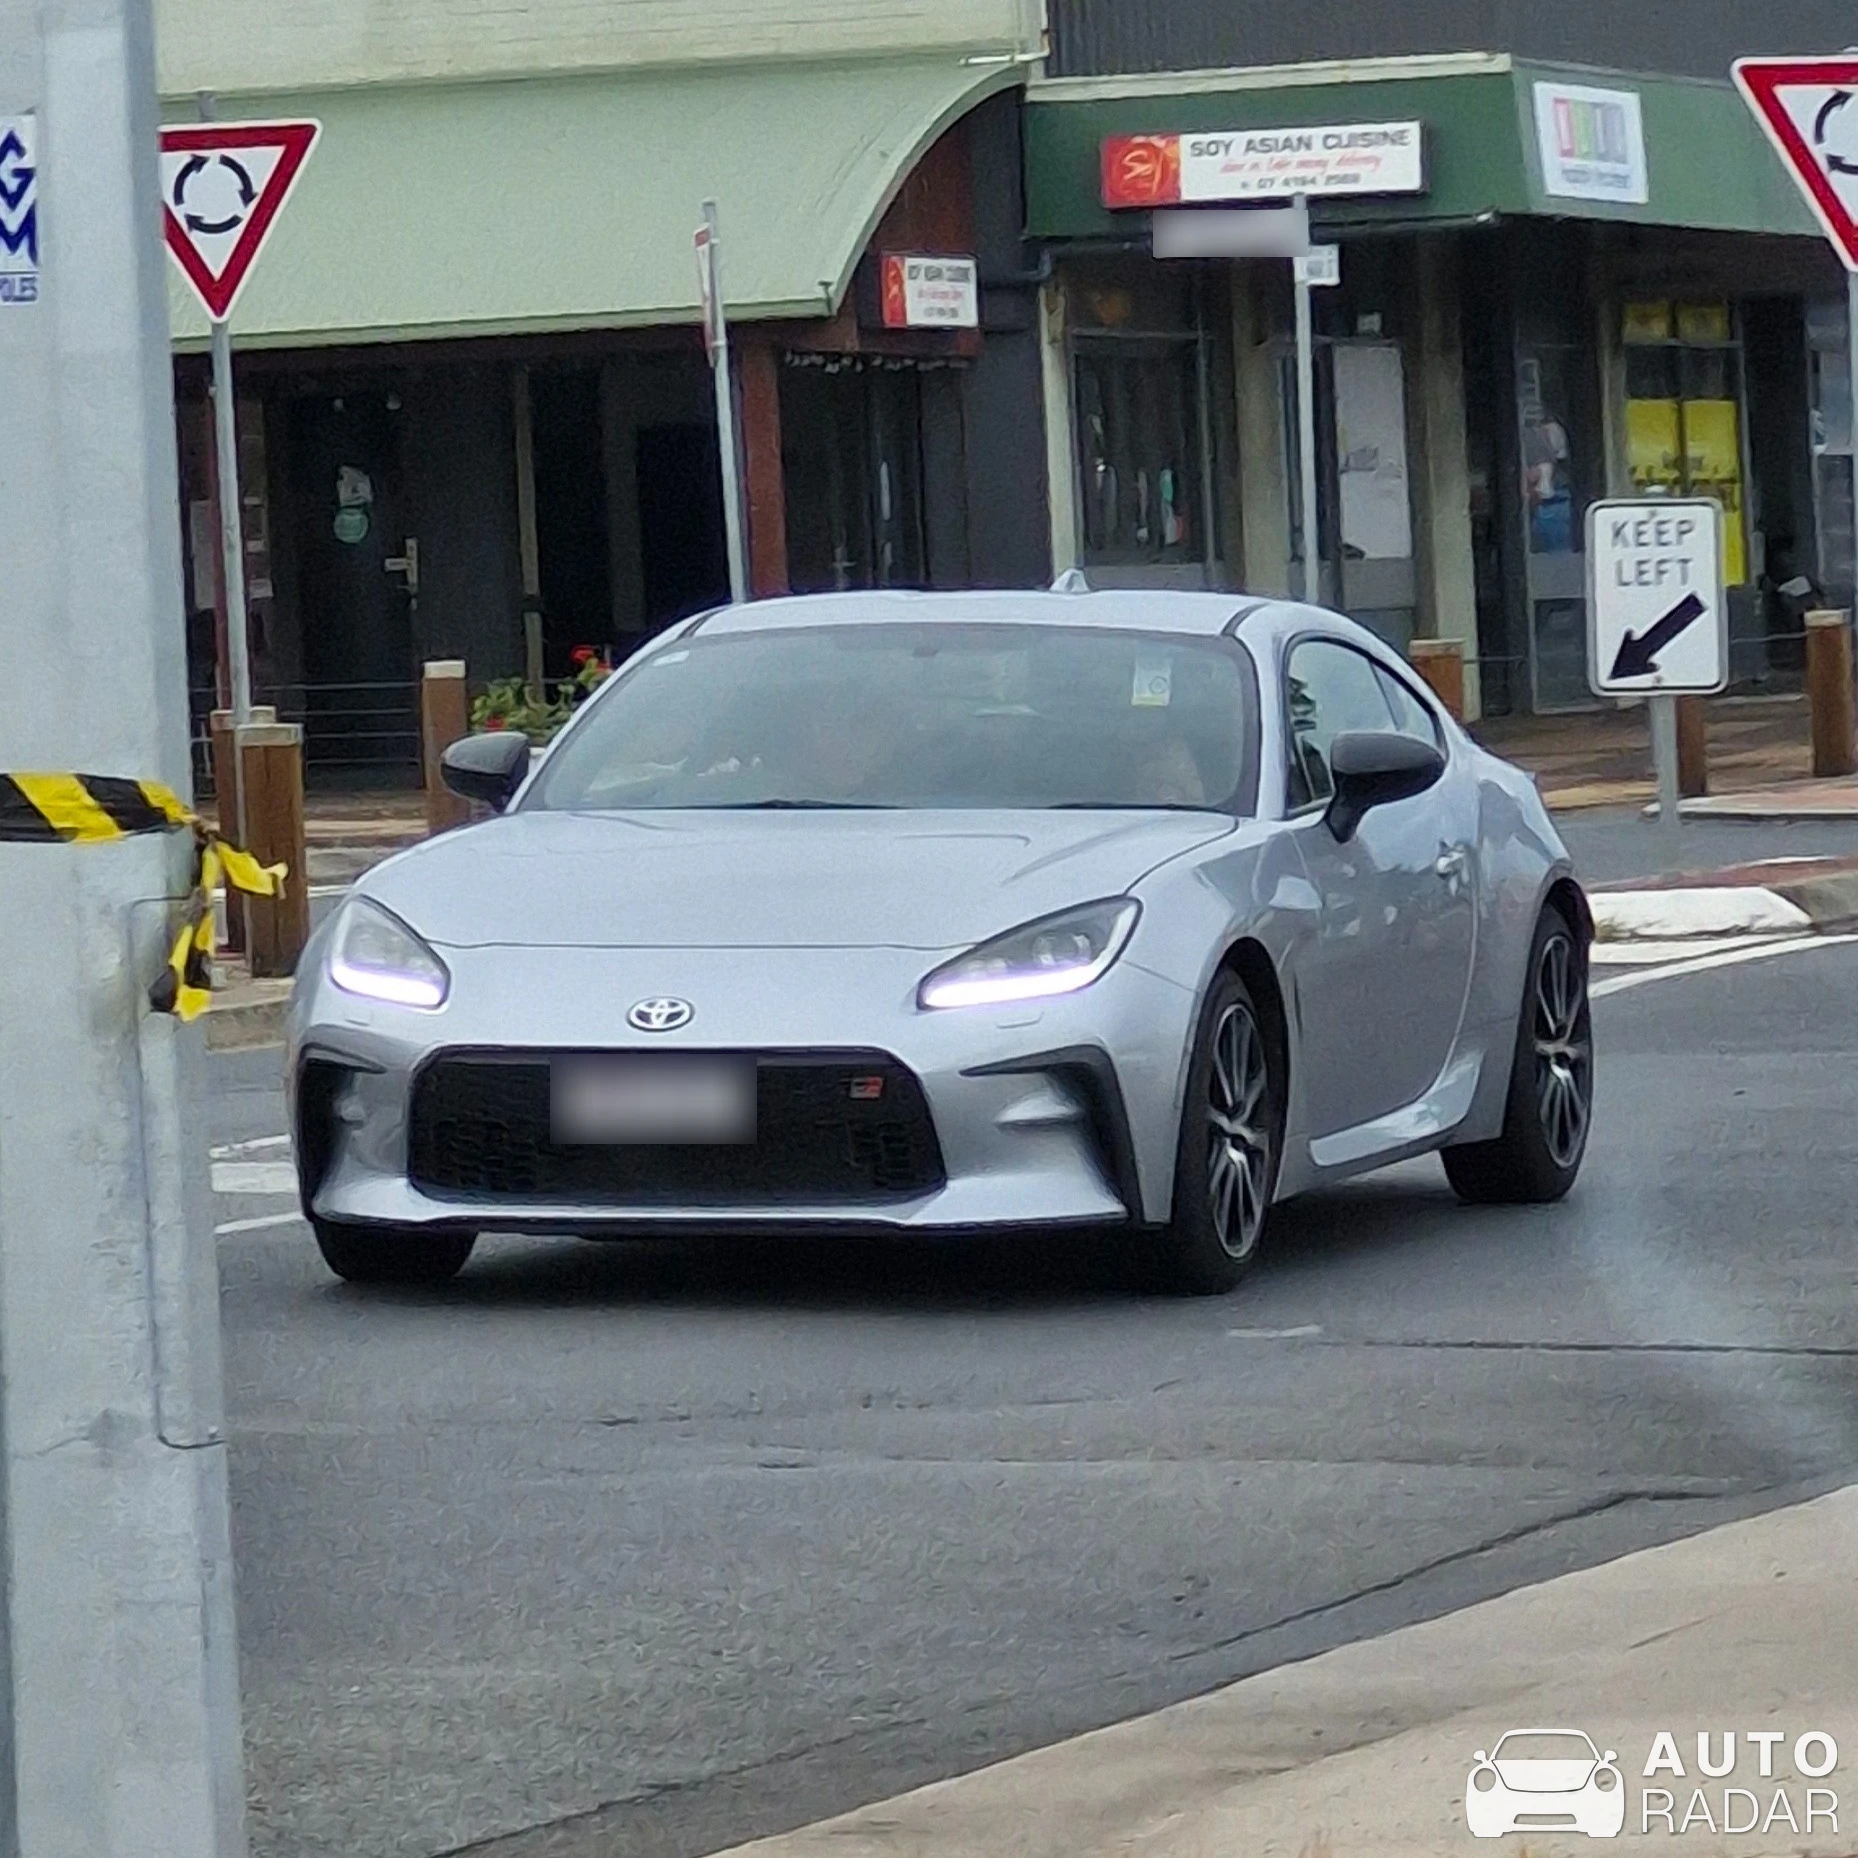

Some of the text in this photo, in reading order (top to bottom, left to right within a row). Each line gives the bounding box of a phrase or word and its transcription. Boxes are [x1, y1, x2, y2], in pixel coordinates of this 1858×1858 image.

[1190, 128, 1411, 157] SOY ASIAN CUISINE
[1611, 518, 1696, 548] KEEP
[1614, 557, 1692, 587] LEFT
